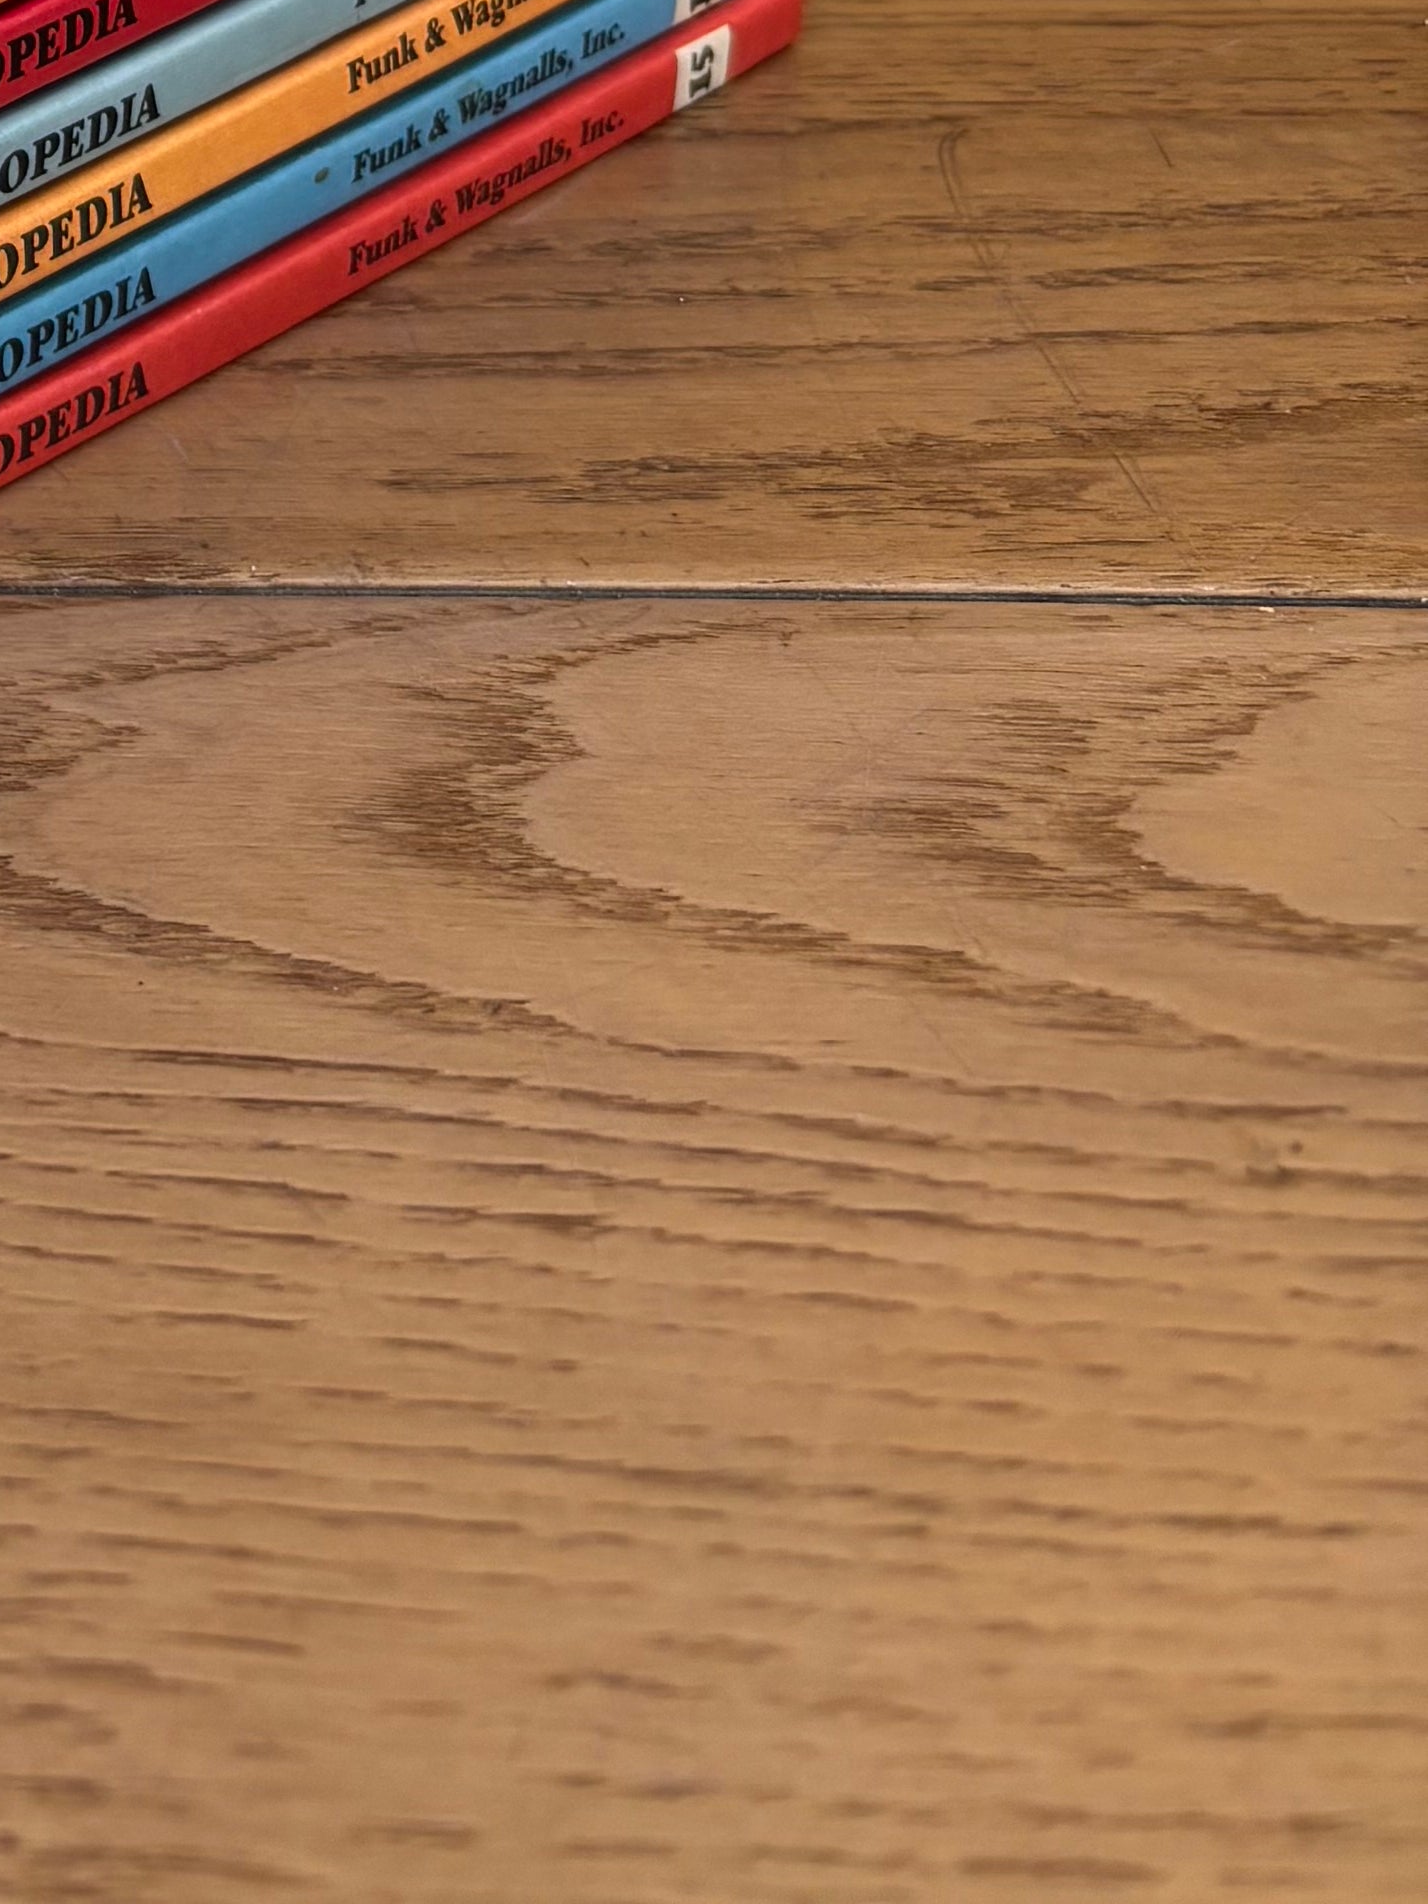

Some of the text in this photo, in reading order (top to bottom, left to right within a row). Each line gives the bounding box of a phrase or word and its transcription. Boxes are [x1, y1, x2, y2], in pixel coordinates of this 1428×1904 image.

[347, 33, 418, 93] Funk
[425, 18, 445, 53] &
[353, 24, 623, 182] Funk & Wagnalls, Inc.
[689, 46, 714, 97] 15
[348, 112, 623, 275] Funk & Wagnalls, Inc.
